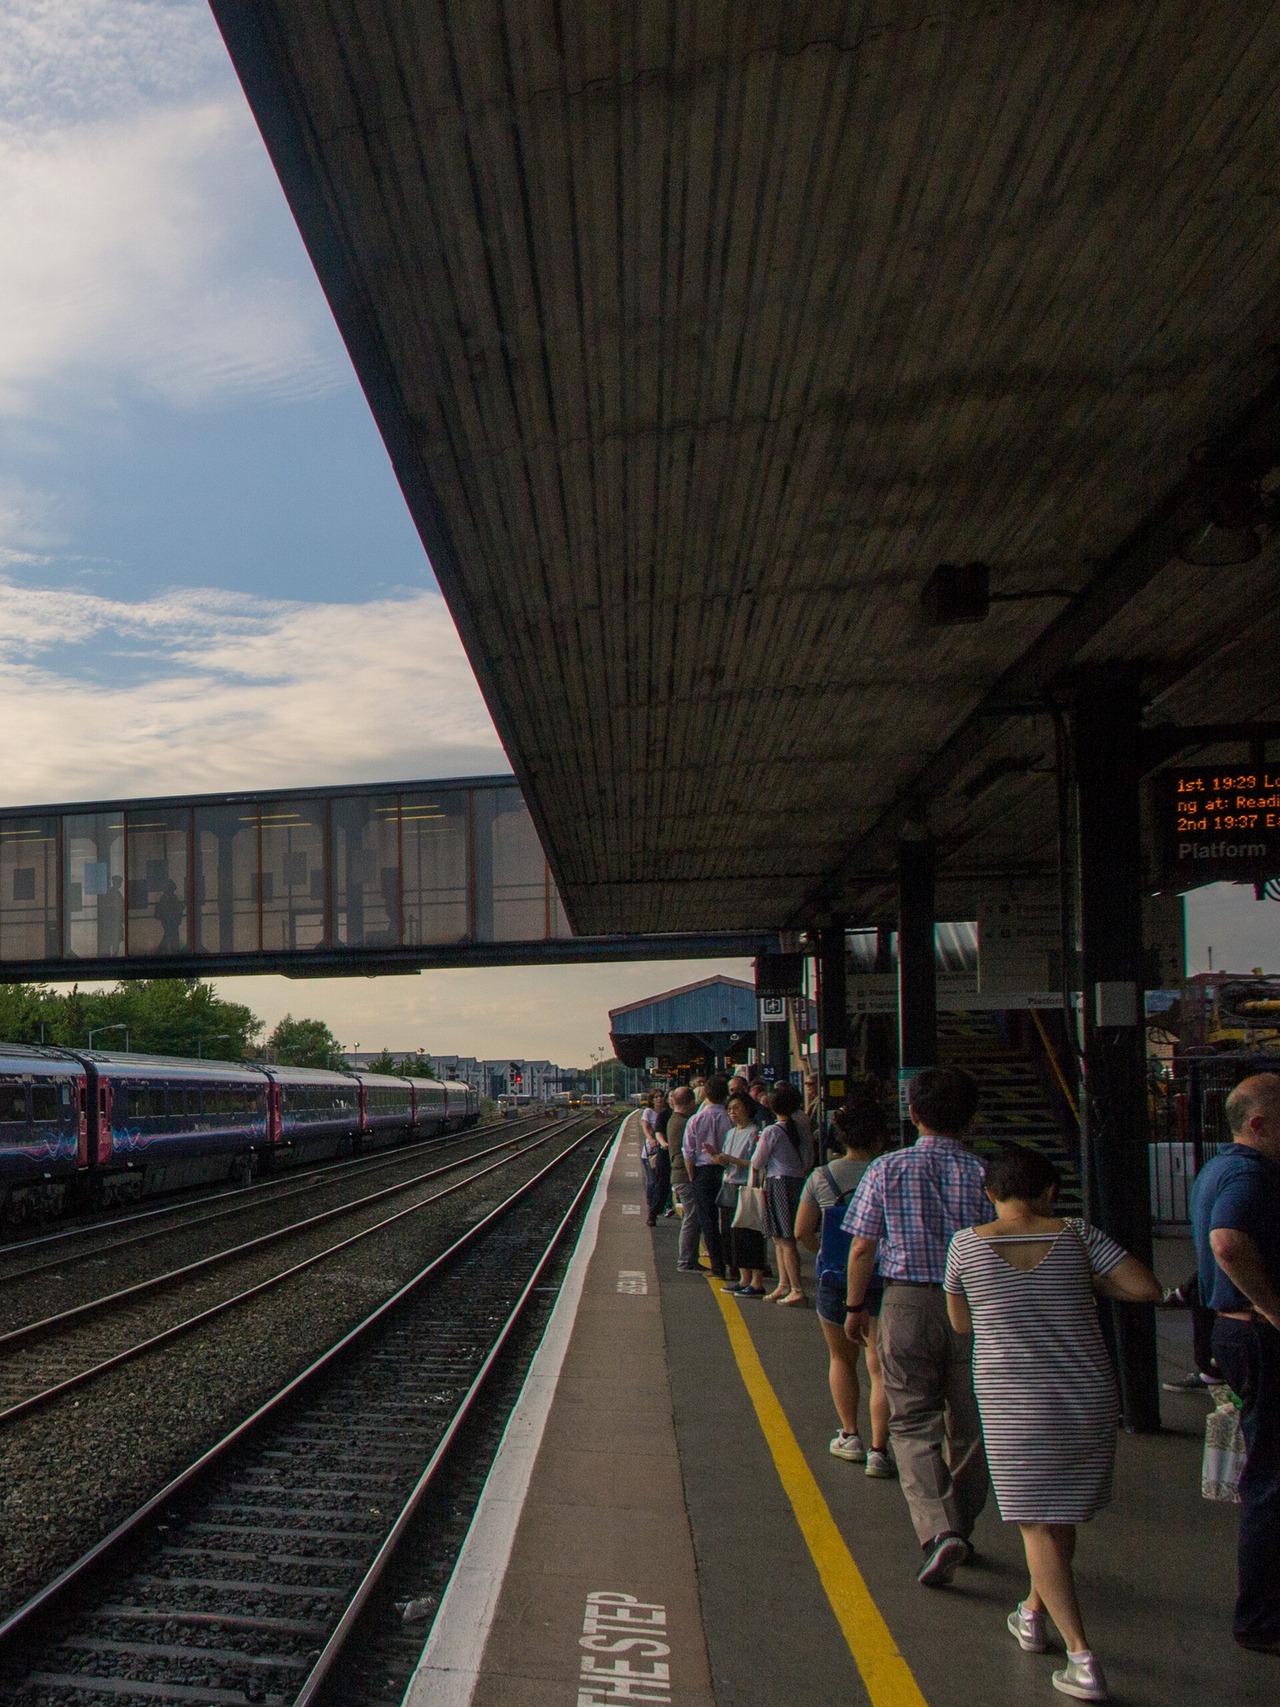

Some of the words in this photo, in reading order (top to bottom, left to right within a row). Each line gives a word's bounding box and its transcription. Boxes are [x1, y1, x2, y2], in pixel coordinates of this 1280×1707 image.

[1177, 778, 1205, 793] 1st
[1213, 775, 1257, 790] 19:29
[1205, 797, 1228, 811] at:
[1177, 817, 1207, 831] 2nd
[1214, 815, 1258, 830] 19:37
[1179, 841, 1266, 859] Platform
[648, 1060, 655, 1068] 3
[763, 1067, 775, 1075] 2-3
[578, 1592, 670, 1656] STEP
